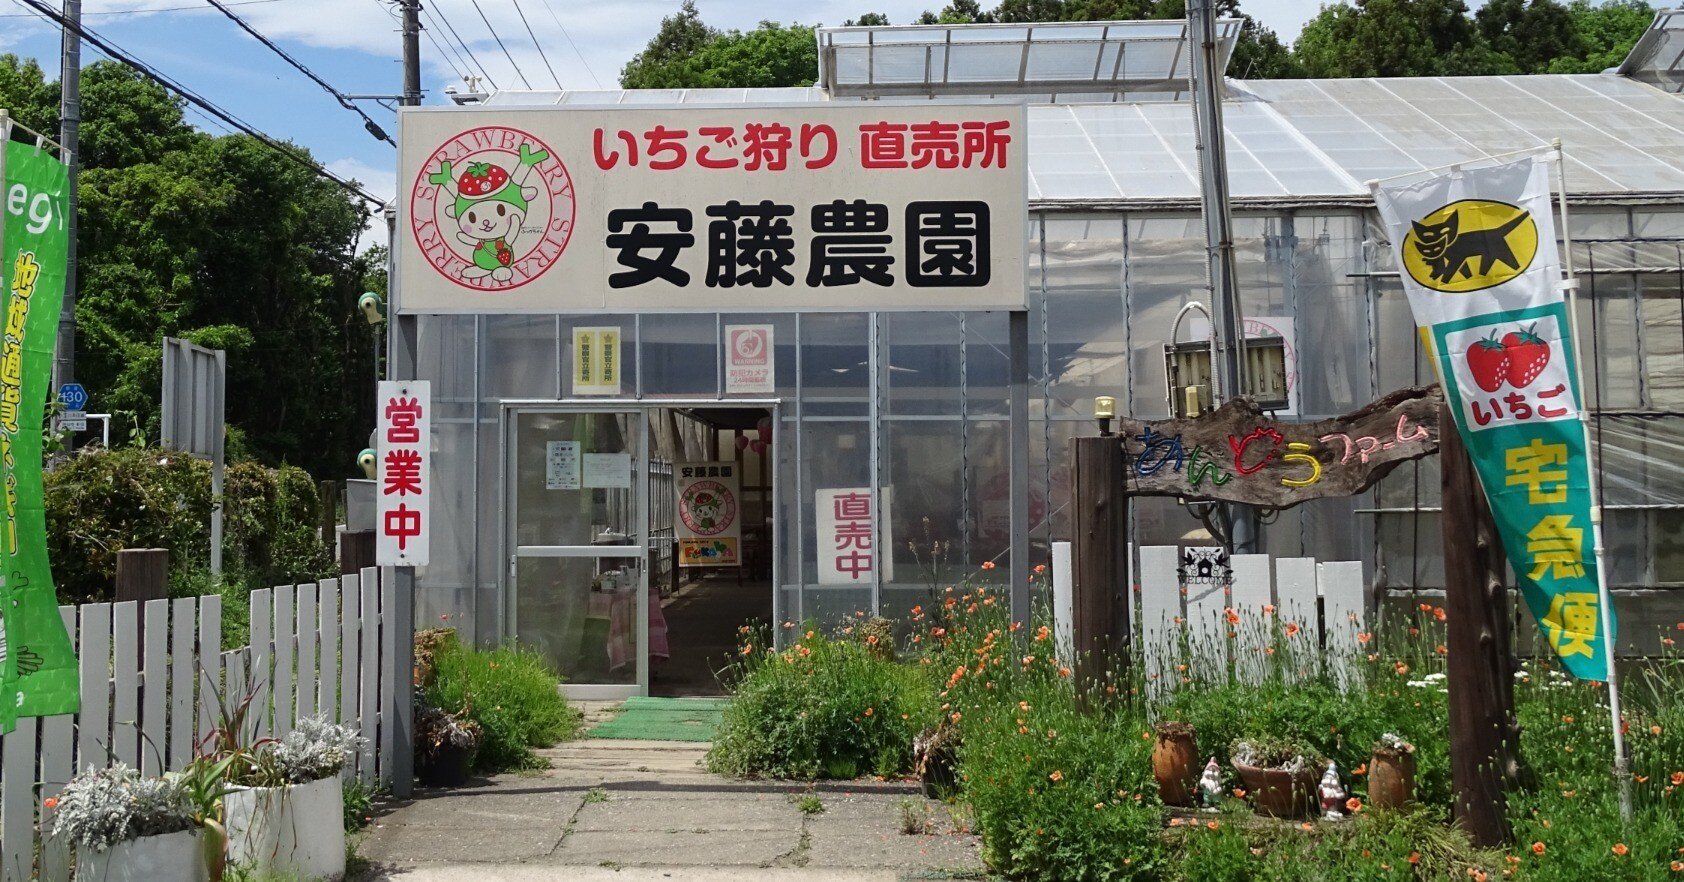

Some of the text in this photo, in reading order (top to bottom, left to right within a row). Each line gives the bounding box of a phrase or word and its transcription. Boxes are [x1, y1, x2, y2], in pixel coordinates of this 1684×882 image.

[593, 120, 1011, 171] いちご狩り 直売所
[606, 199, 991, 288] 安藤農園
[1471, 383, 1567, 426] いちご
[384, 397, 422, 550] 営業中
[833, 492, 872, 579] 直売中
[1505, 438, 1600, 660] 宅急便
[1178, 575, 1233, 585] WELCOME
